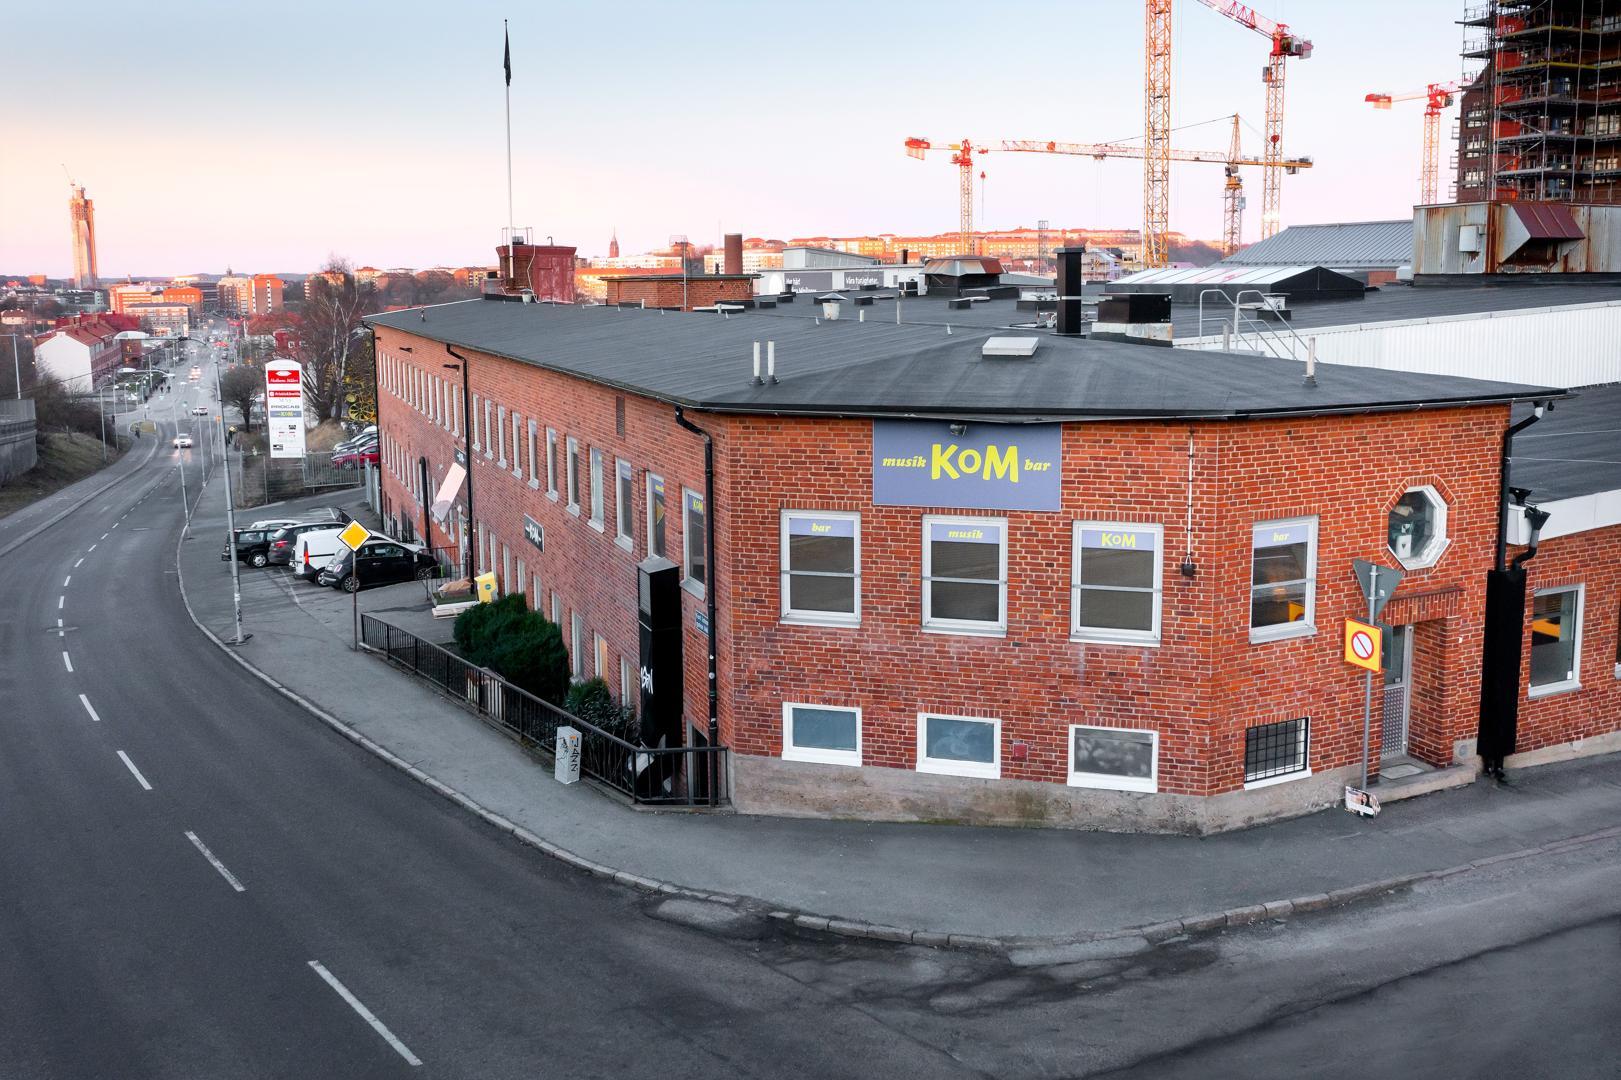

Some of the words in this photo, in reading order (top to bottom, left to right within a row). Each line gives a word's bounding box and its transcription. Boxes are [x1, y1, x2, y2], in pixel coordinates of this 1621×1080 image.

[882, 455, 927, 468] musik
[1024, 459, 1051, 471] bar
[811, 522, 832, 532] bar
[948, 529, 983, 539] musik
[1273, 532, 1290, 542] bar
